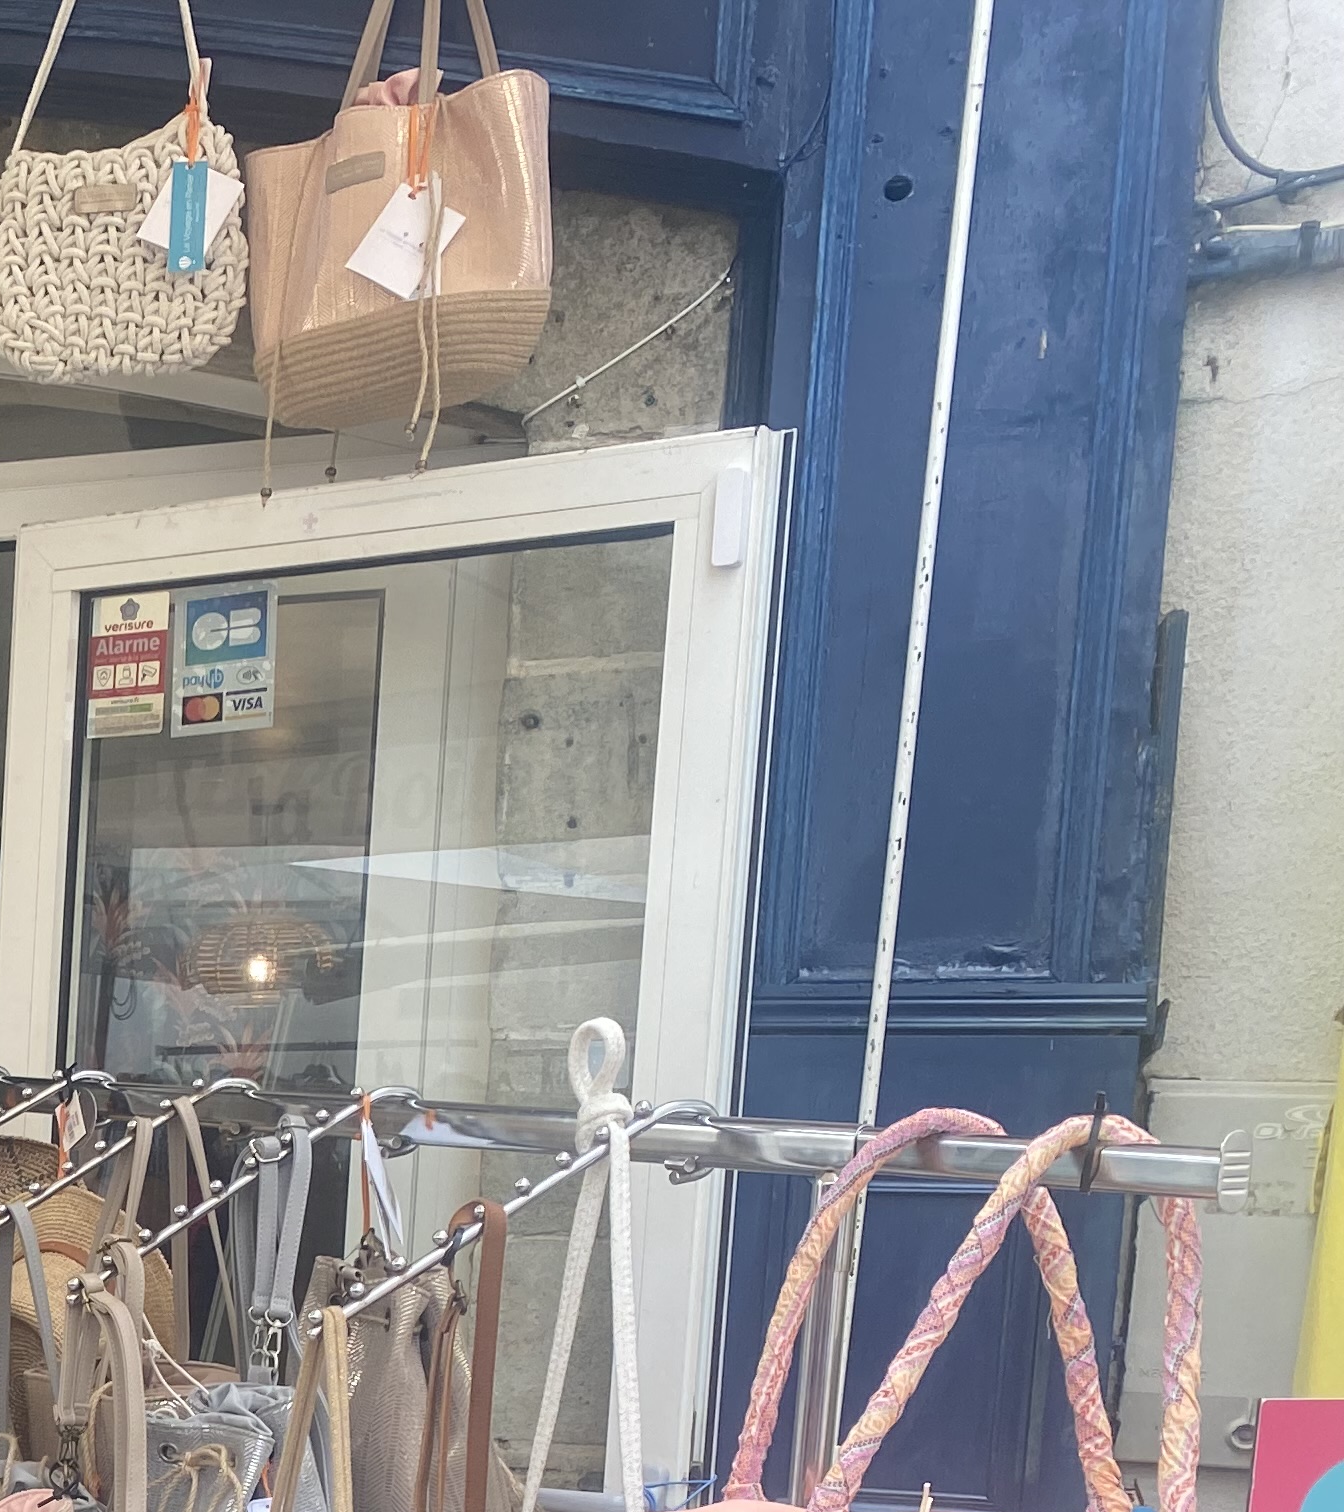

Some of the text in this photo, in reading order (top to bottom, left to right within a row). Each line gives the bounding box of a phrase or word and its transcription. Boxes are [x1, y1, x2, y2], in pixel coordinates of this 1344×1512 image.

[104, 618, 154, 634] verisure
[95, 635, 161, 657] Alarme
[231, 695, 264, 712] VISA
